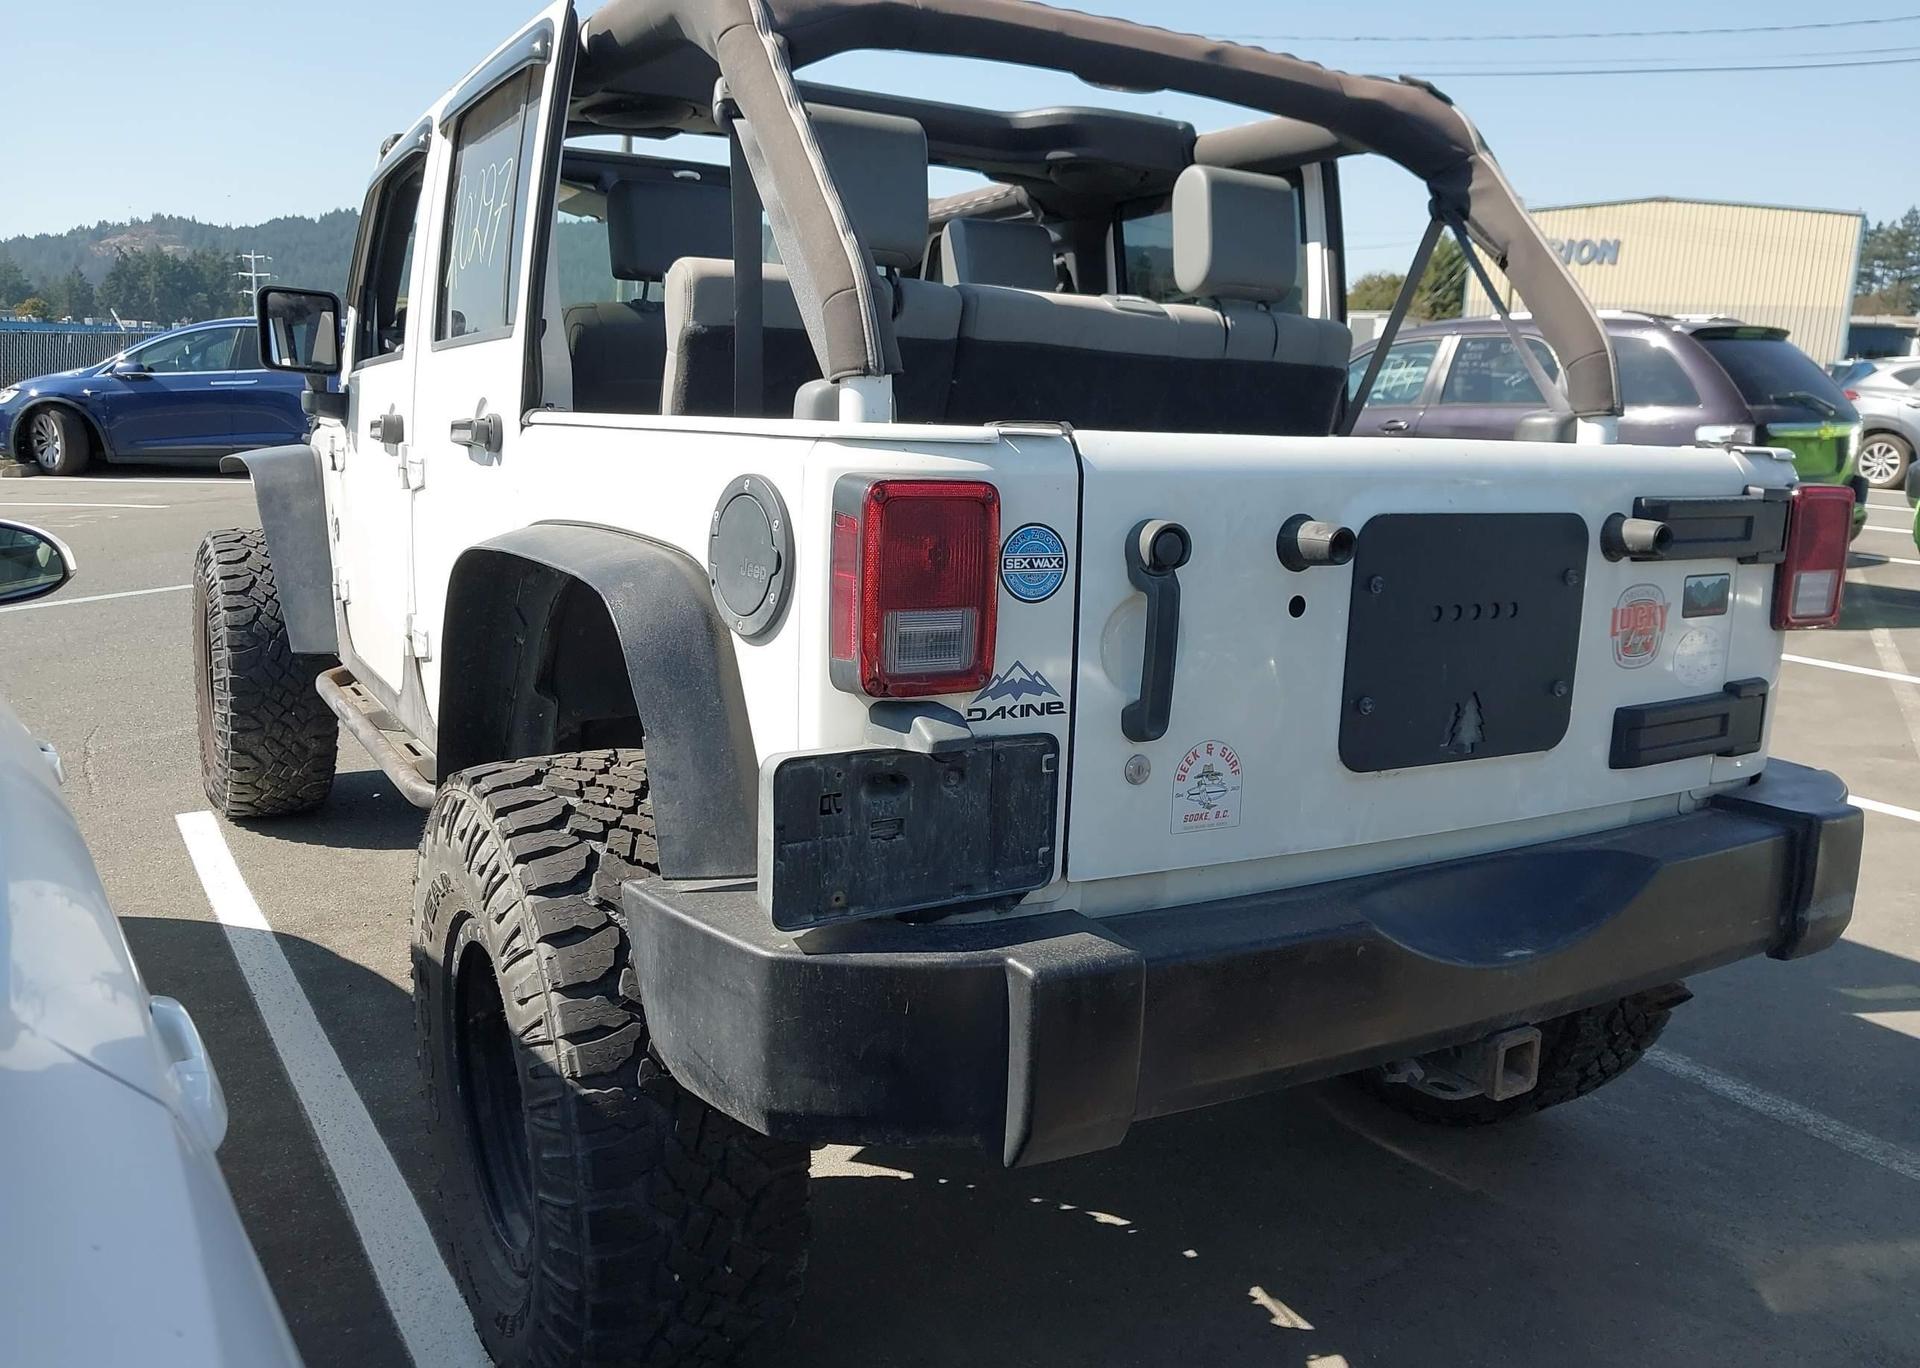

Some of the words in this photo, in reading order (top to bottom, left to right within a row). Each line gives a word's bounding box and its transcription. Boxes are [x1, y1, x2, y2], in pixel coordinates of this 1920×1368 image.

[740, 556, 767, 583] Jeep
[1005, 558, 1031, 569] SEX
[1031, 557, 1060, 568] WAX
[965, 701, 1067, 722] DAKINE
[1176, 749, 1201, 782] SEEK
[1206, 743, 1214, 757] &
[1219, 746, 1241, 776] SURF
